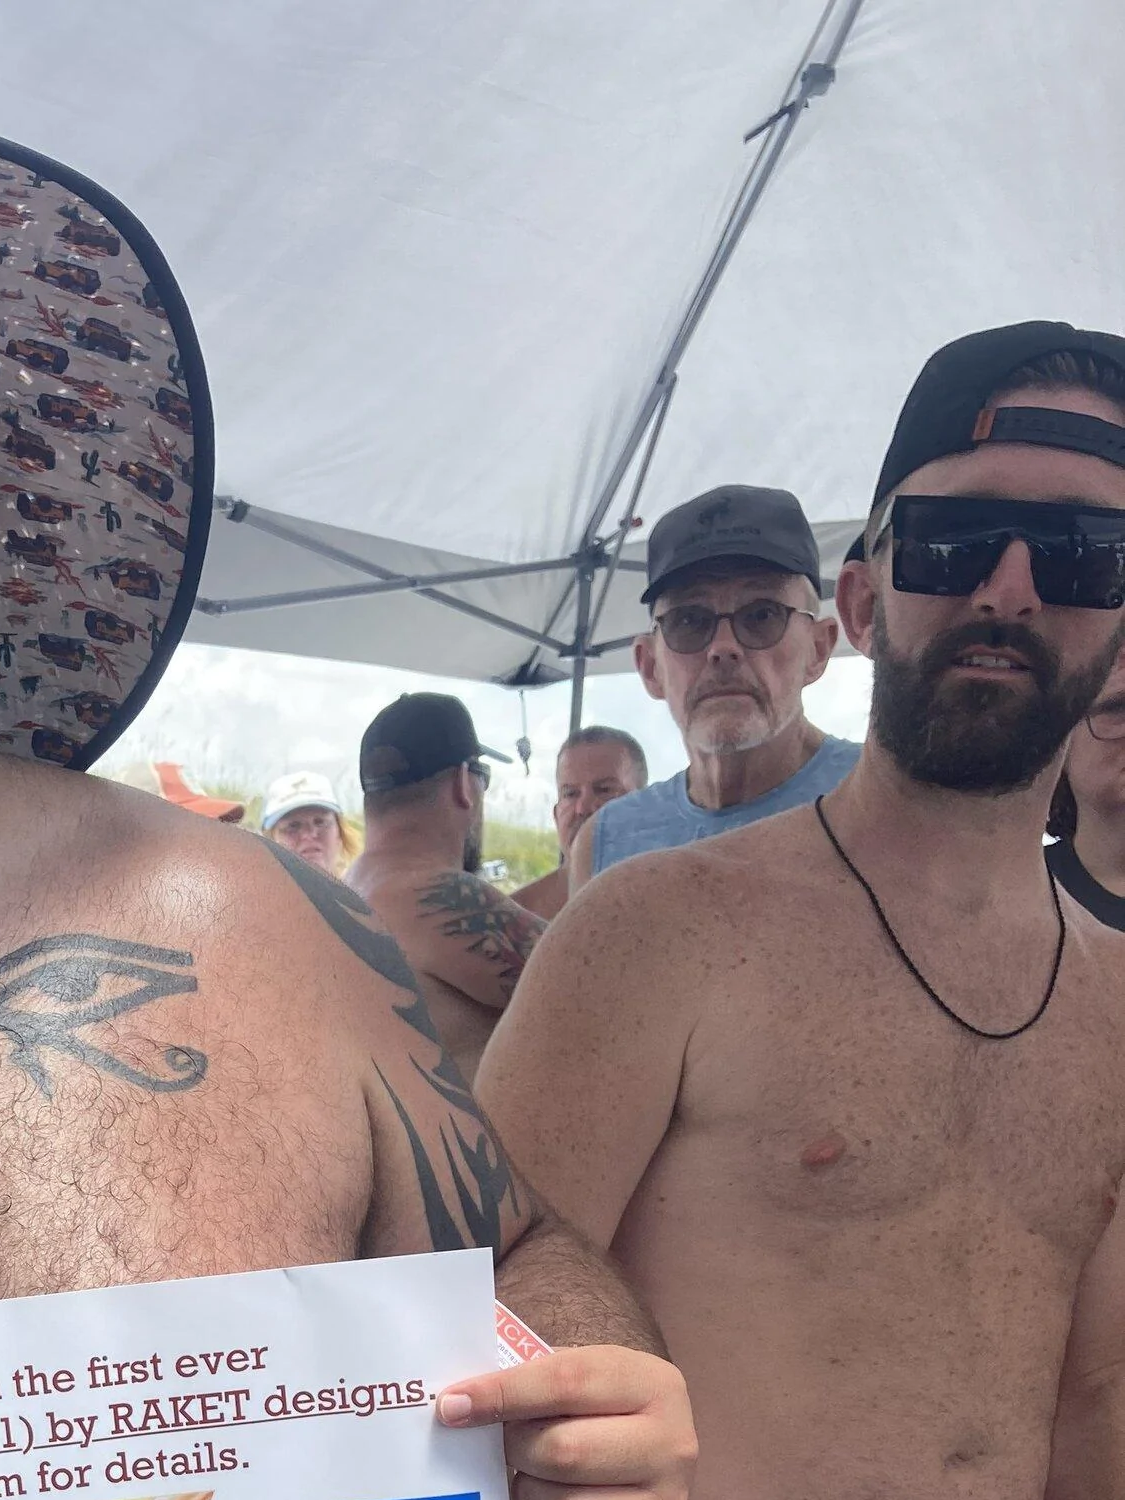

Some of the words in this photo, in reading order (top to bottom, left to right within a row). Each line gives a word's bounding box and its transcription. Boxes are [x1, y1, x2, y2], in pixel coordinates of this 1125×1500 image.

[12, 1365, 75, 1397] the
[87, 1352, 163, 1388] first
[175, 1346, 268, 1378] ever
[46, 1411, 98, 1448] by
[109, 1389, 250, 1434] RAKET
[264, 1373, 437, 1417] designs.
[37, 1461, 92, 1493] for
[105, 1441, 249, 1483] details.
